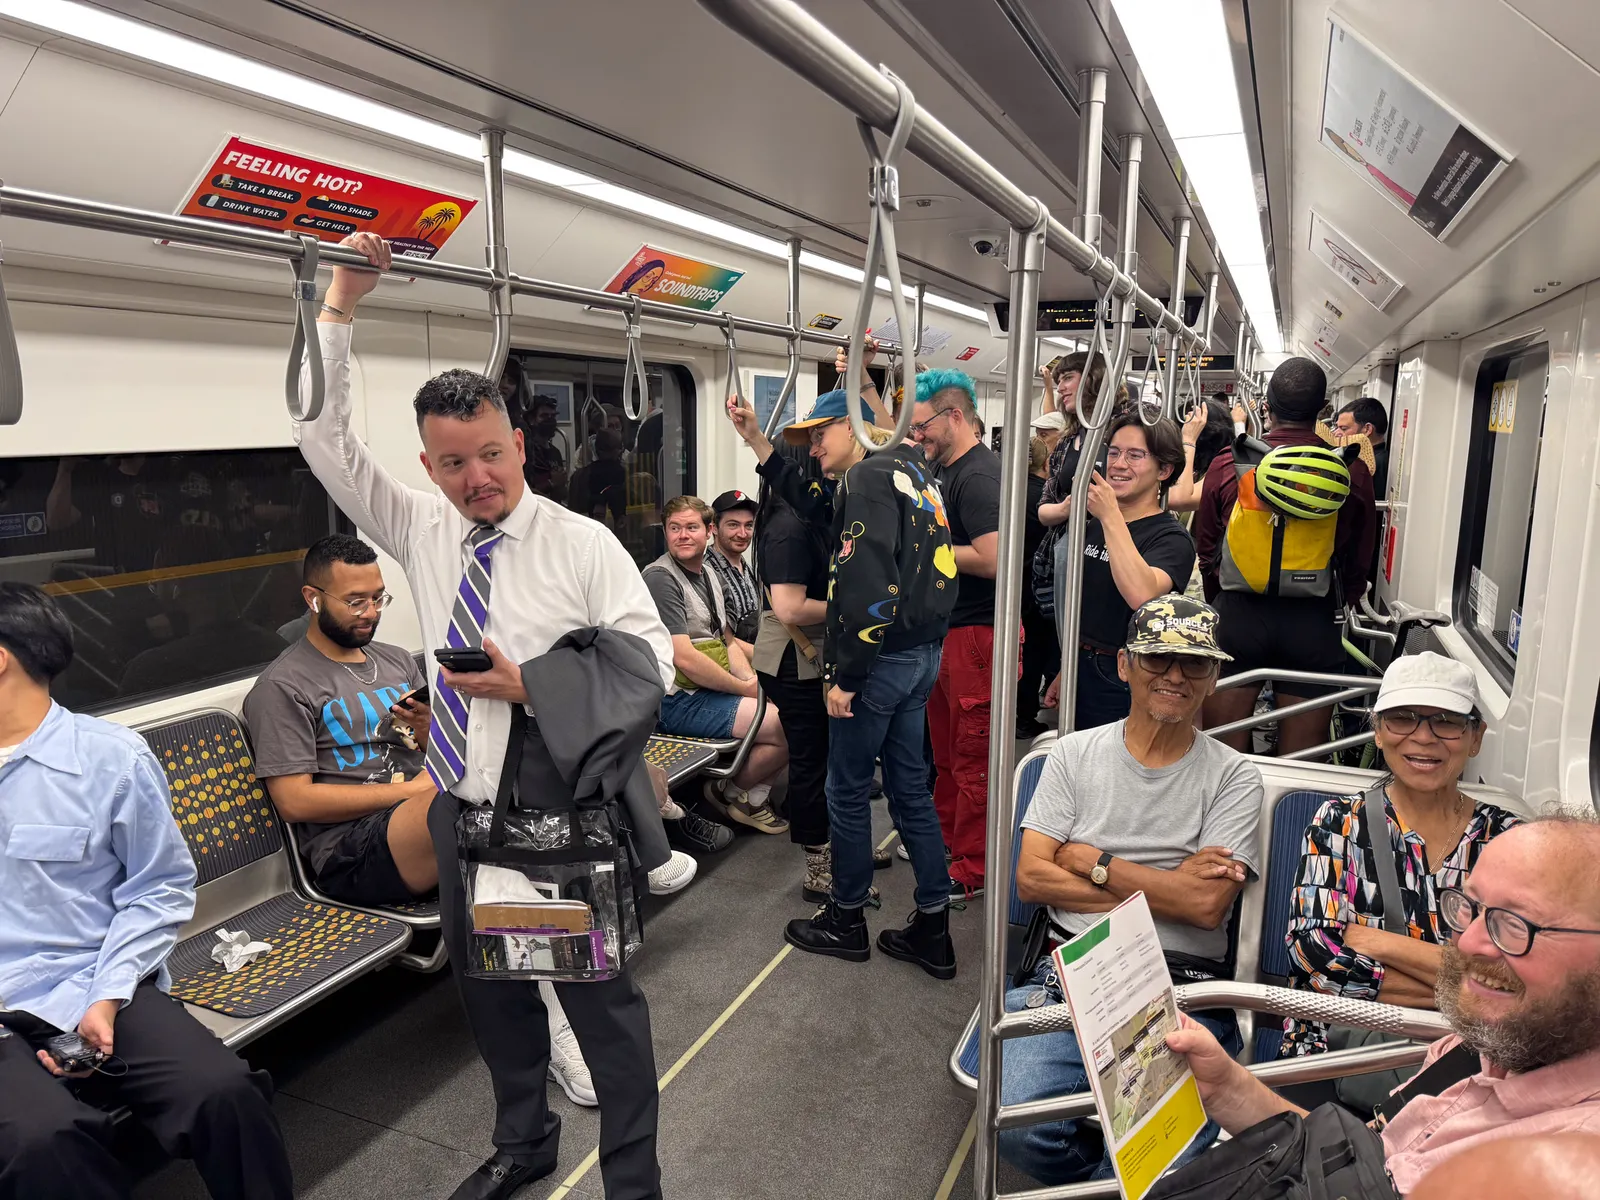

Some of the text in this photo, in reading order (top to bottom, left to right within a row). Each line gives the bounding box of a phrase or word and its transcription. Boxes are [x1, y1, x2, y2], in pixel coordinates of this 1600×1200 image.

[223, 150, 363, 195] FEELING HOT?
[237, 182, 258, 193] TAKE
[266, 189, 294, 201] BREAK.
[222, 201, 280, 218] DRINK WATER.
[328, 203, 373, 218] FIND SHADE.
[316, 220, 351, 232] GET HELP.
[654, 278, 724, 303] SOUNDTRIPS
[1084, 544, 1100, 558] Ride
